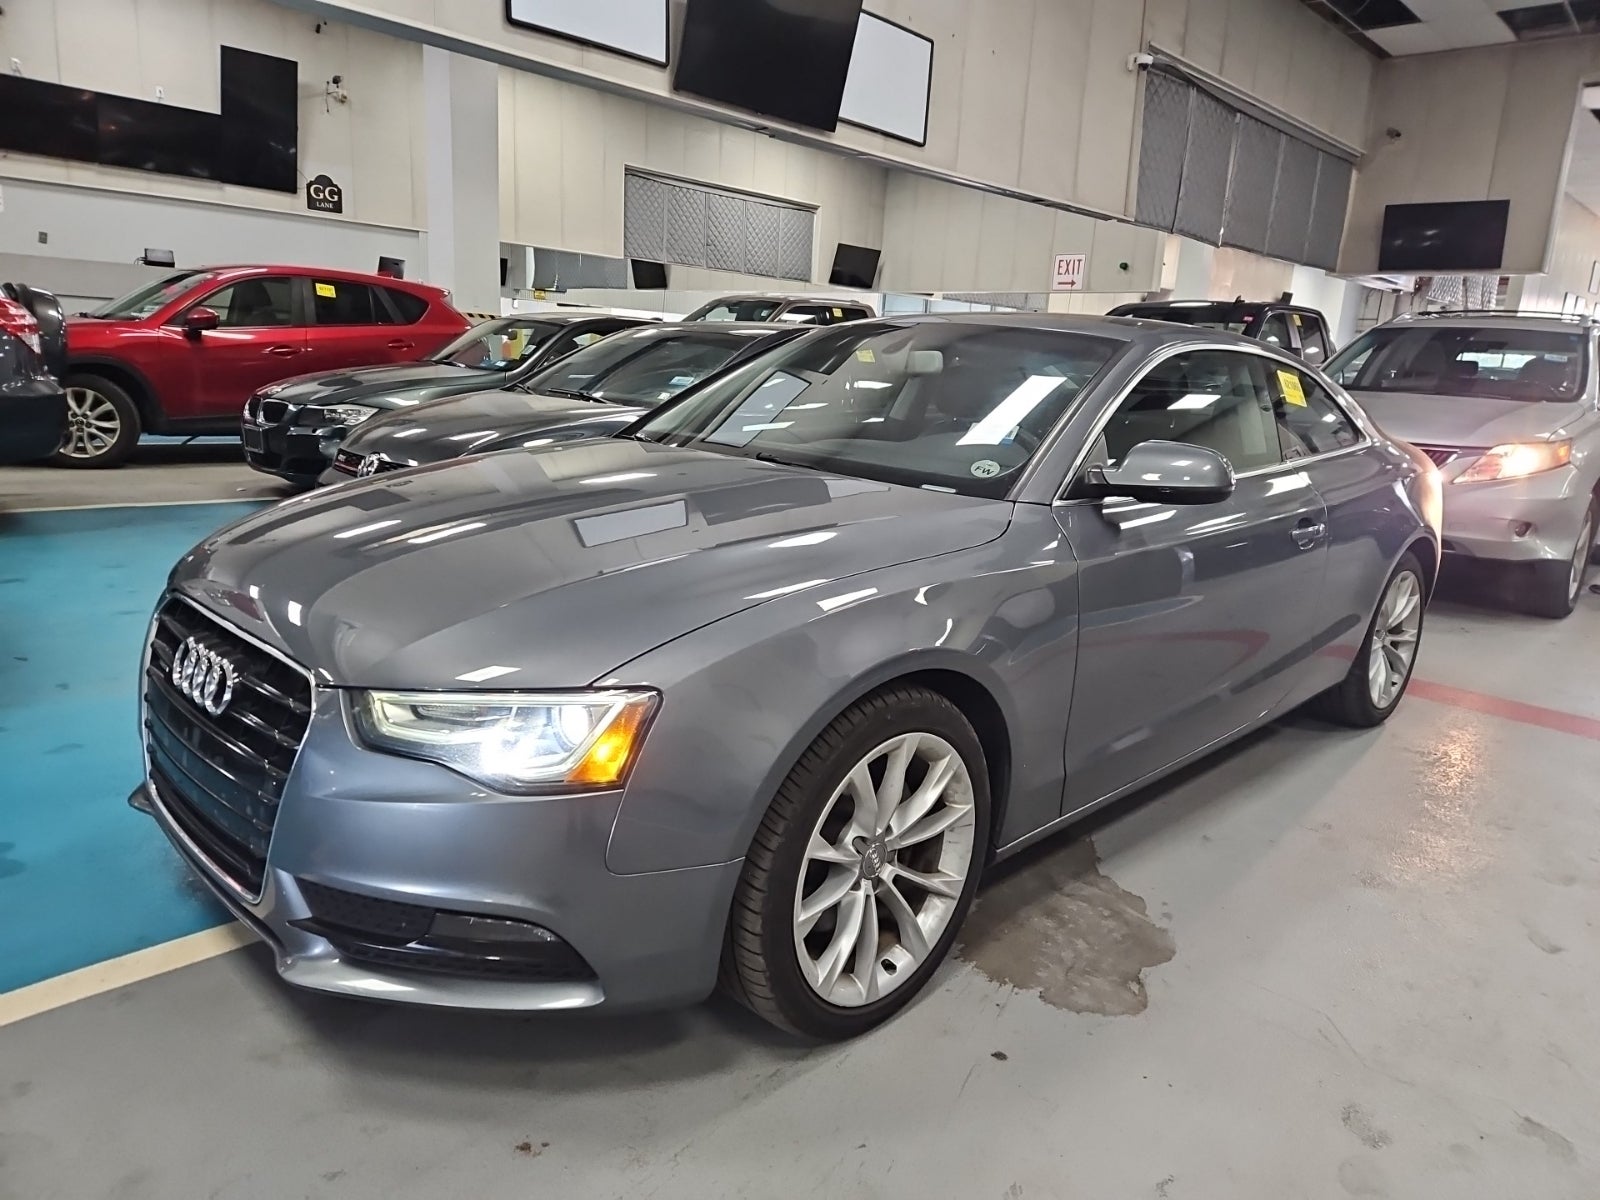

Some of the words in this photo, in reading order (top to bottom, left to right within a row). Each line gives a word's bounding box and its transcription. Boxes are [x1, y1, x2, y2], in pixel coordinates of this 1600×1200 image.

[310, 184, 339, 202] GG
[316, 201, 334, 209] LANE
[1057, 259, 1083, 276] EXIT
